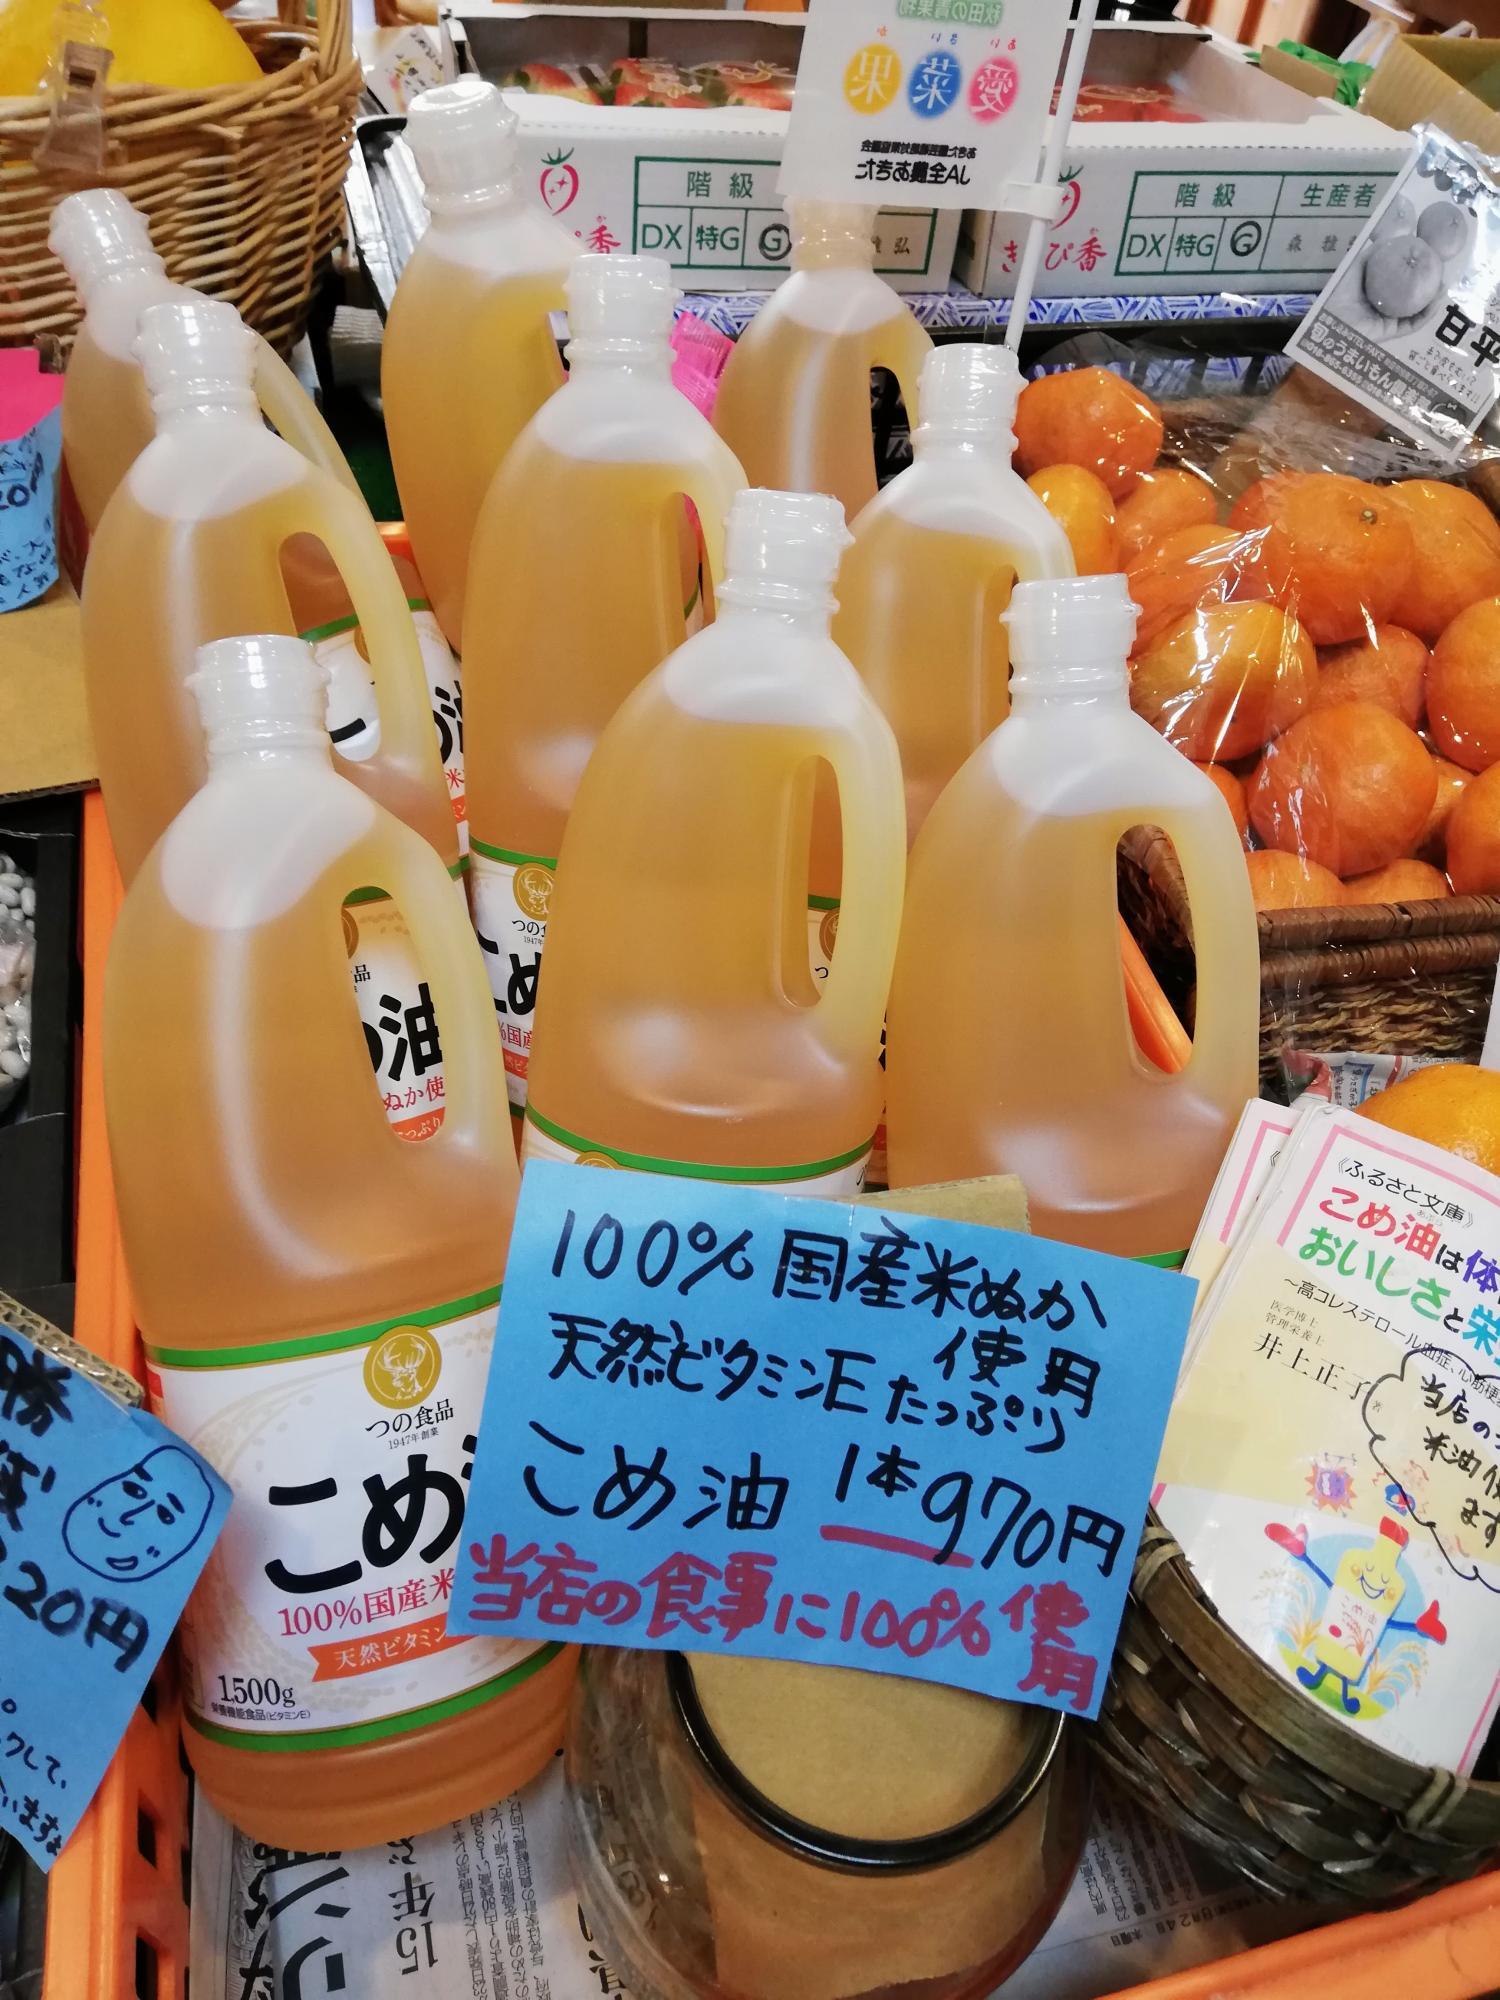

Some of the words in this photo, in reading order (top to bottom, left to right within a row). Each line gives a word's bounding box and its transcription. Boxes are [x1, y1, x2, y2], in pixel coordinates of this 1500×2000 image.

[686, 170, 754, 199] 階級
[1175, 182, 1237, 208] 階級
[1299, 182, 1377, 209] 生産者
[640, 223, 684, 251] DX
[695, 224, 740, 252] 特G
[761, 226, 788, 255] G
[1125, 233, 1166, 258] DX
[1174, 233, 1215, 257] 特G
[397, 1115, 441, 1139] っぷり
[933, 1325, 1101, 1418] 使用
[1252, 1331, 1371, 1401] 井上正子
[364, 1398, 455, 1440] つの食品
[1420, 1373, 1500, 1450] 当店の
[523, 1420, 790, 1531] こめ油
[264, 1434, 478, 1594] こめ
[278, 1567, 456, 1637] 100%国産米
